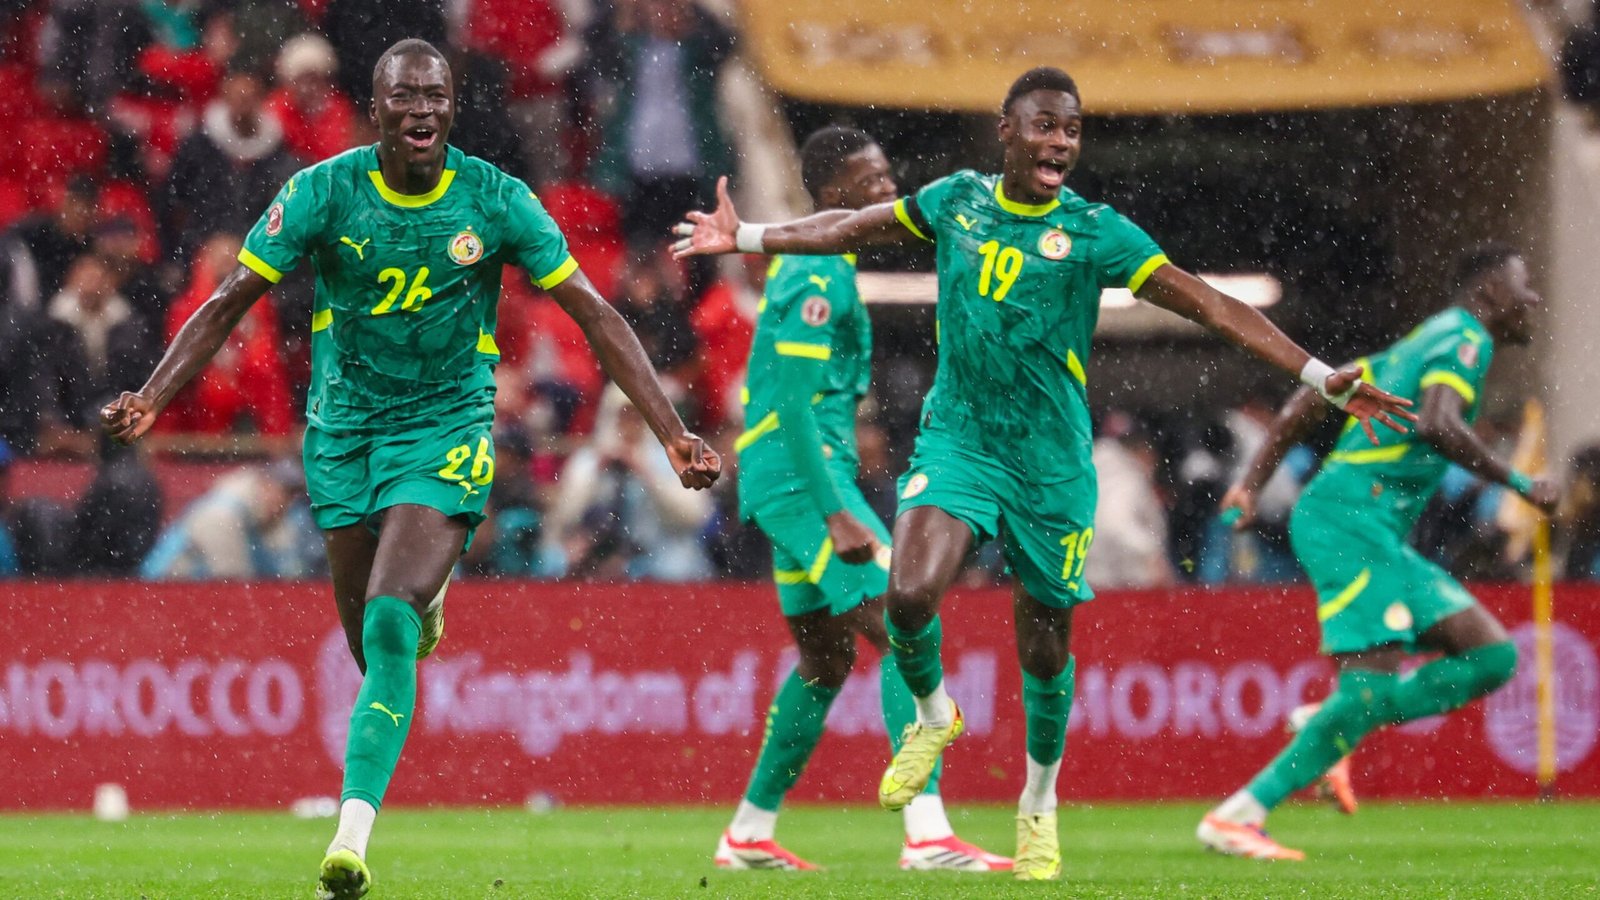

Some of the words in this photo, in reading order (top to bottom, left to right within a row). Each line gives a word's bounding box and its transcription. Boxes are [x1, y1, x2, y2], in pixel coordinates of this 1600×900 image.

[371, 266, 432, 315] 26
[978, 240, 1024, 302] 19
[438, 436, 494, 486] 26
[1060, 527, 1093, 580] 19
[1067, 658, 1446, 739] OROC
